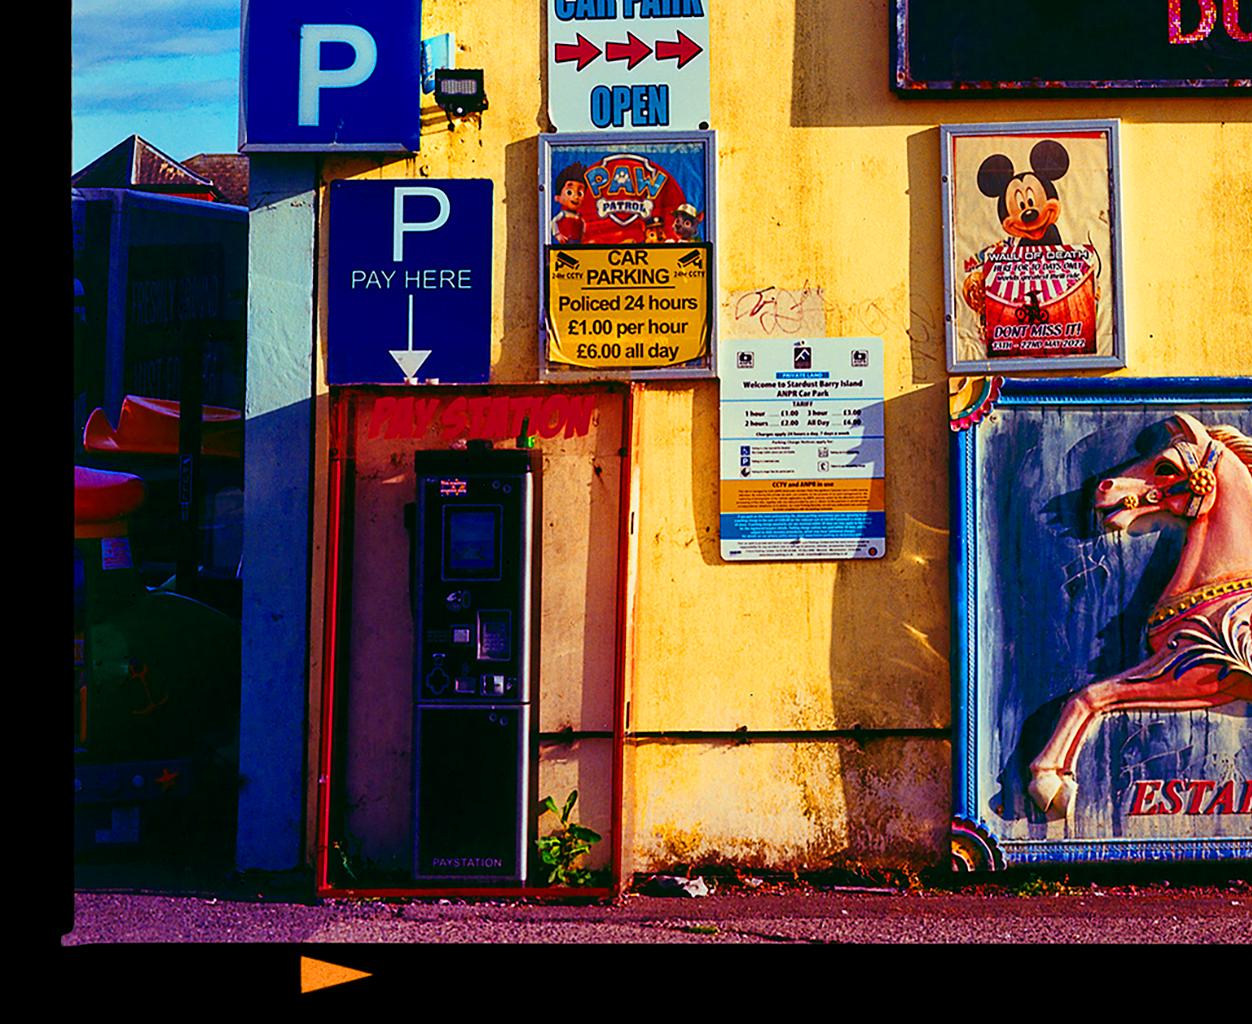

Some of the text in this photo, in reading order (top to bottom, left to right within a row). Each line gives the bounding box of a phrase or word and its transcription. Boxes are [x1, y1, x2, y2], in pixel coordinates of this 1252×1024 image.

[297, 24, 378, 127] P
[590, 84, 669, 128] OPEN
[584, 165, 668, 199] PAW
[602, 200, 646, 213] PATROL
[393, 186, 451, 263] P
[608, 250, 648, 266] CAR
[989, 250, 1089, 261] WALL OF DEATH
[351, 269, 473, 289] PAY HERE
[586, 269, 670, 285] PARKING
[559, 295, 698, 312] Policed 24 hours
[568, 320, 688, 338] £1.00 per hour
[994, 322, 1082, 338] DONT MISS IT!
[576, 343, 680, 361] £6.00 all day
[787, 380, 818, 388] Stardust
[819, 380, 840, 389] Barry
[840, 379, 863, 387] Island
[812, 389, 829, 397] Park
[368, 394, 597, 440] PAY STATION
[432, 857, 502, 868] PAYSTATION
